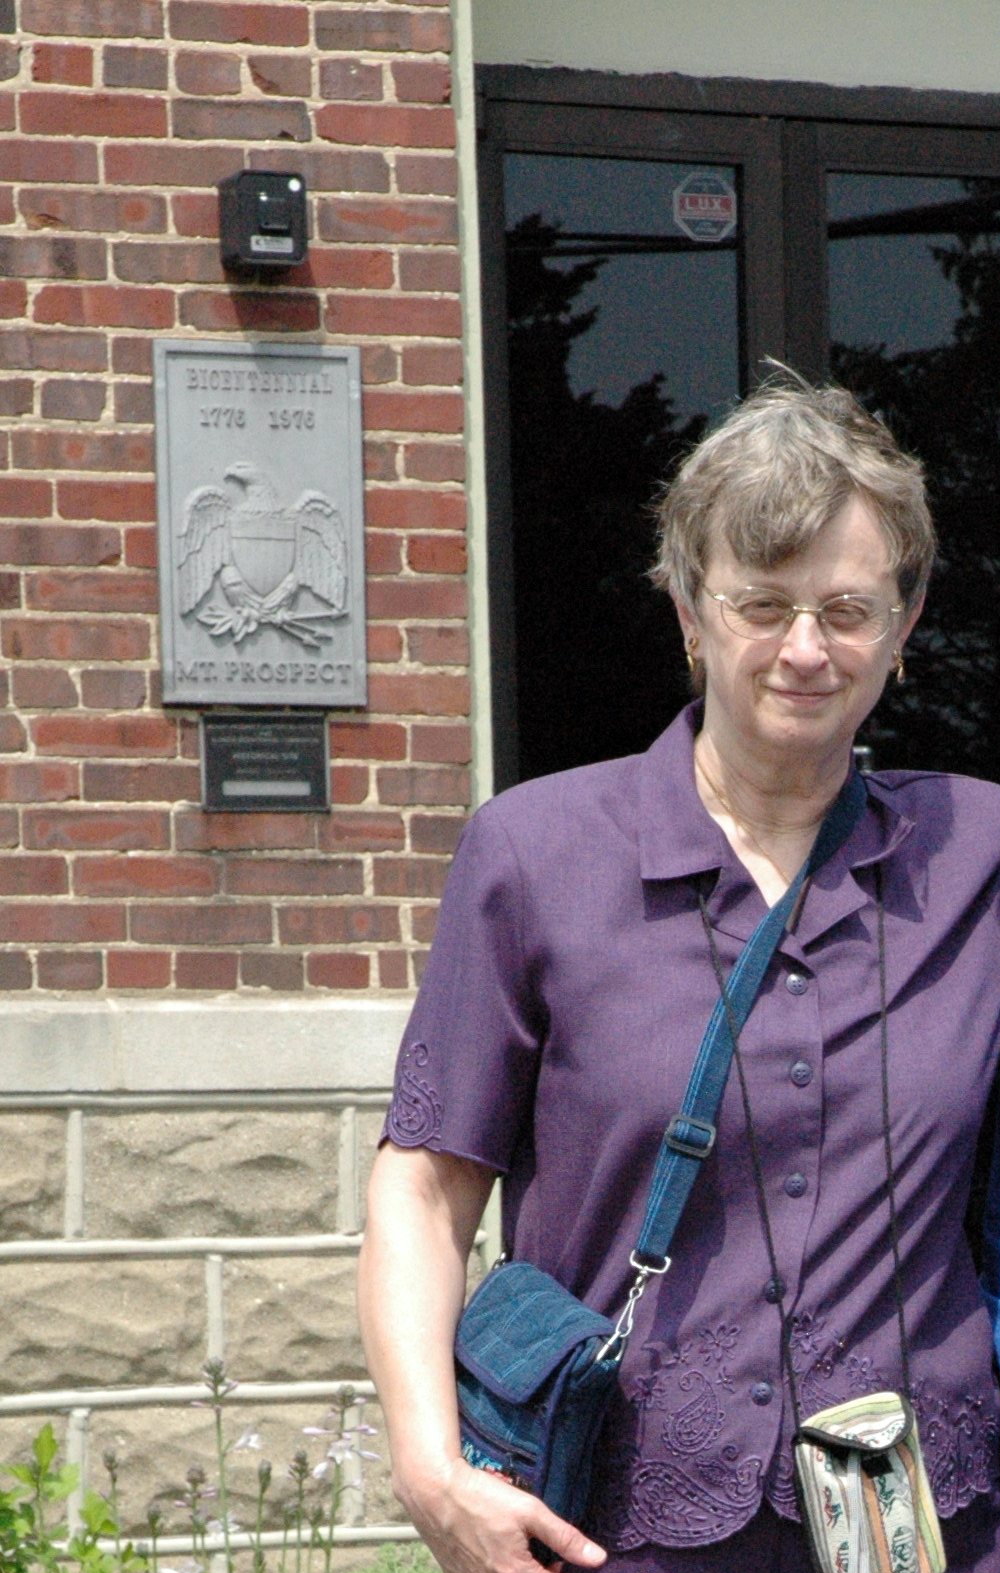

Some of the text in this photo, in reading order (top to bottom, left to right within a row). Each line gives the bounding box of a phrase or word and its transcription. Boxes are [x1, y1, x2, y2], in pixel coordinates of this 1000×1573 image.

[186, 367, 333, 395] BICENTENNIAL
[199, 407, 316, 431] 1776 1976
[176, 661, 353, 686] MT. PROSPECT
